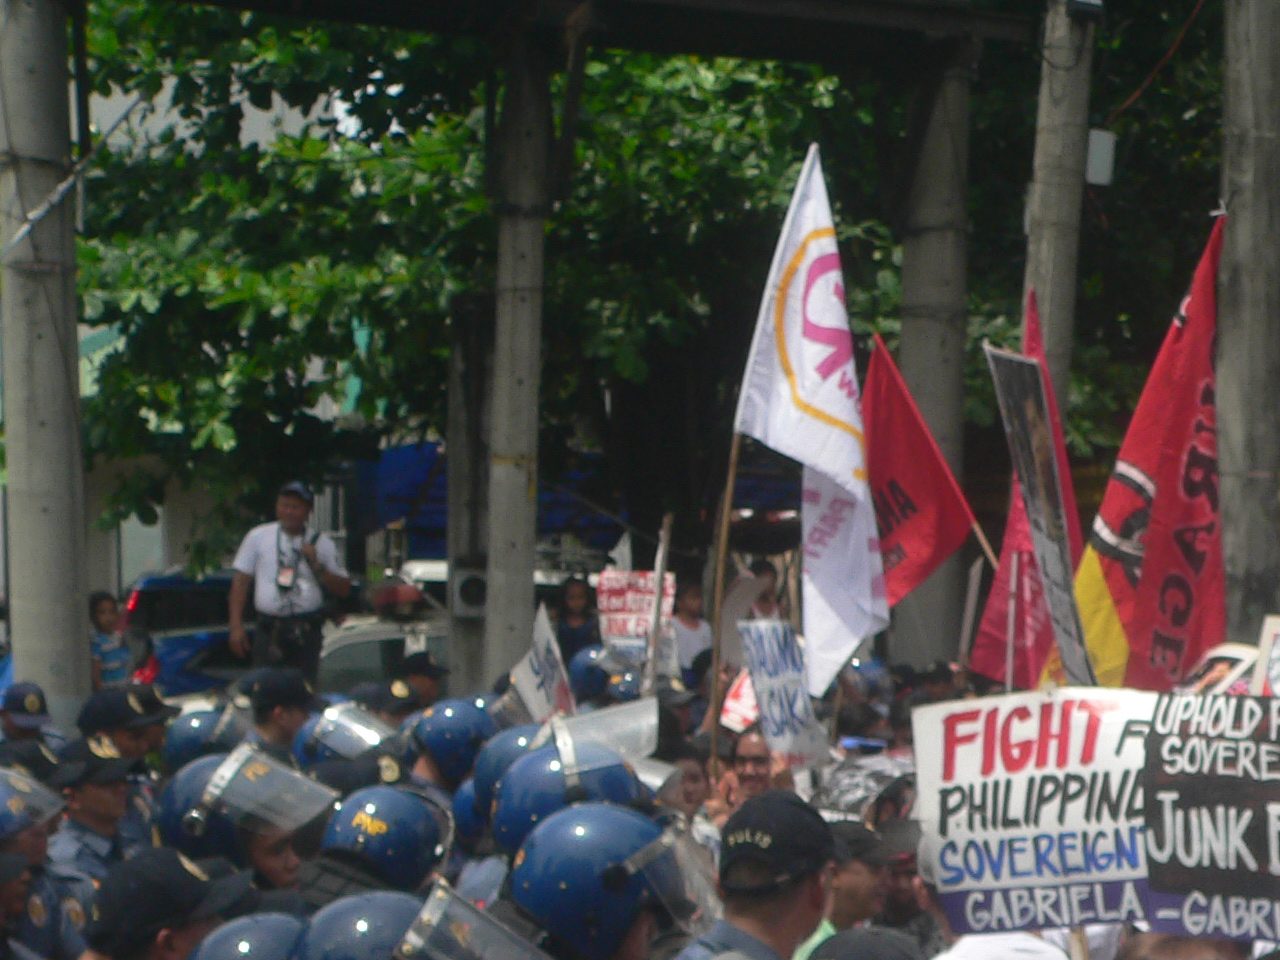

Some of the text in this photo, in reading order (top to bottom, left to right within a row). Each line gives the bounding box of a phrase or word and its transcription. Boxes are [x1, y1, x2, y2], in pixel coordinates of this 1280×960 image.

[942, 698, 1120, 783] FIGHT
[1154, 694, 1263, 740] UPHOLD
[938, 824, 1148, 886] SOVEREIGN
[1147, 790, 1260, 872] JUNK
[966, 882, 1145, 931] GABRIELA
